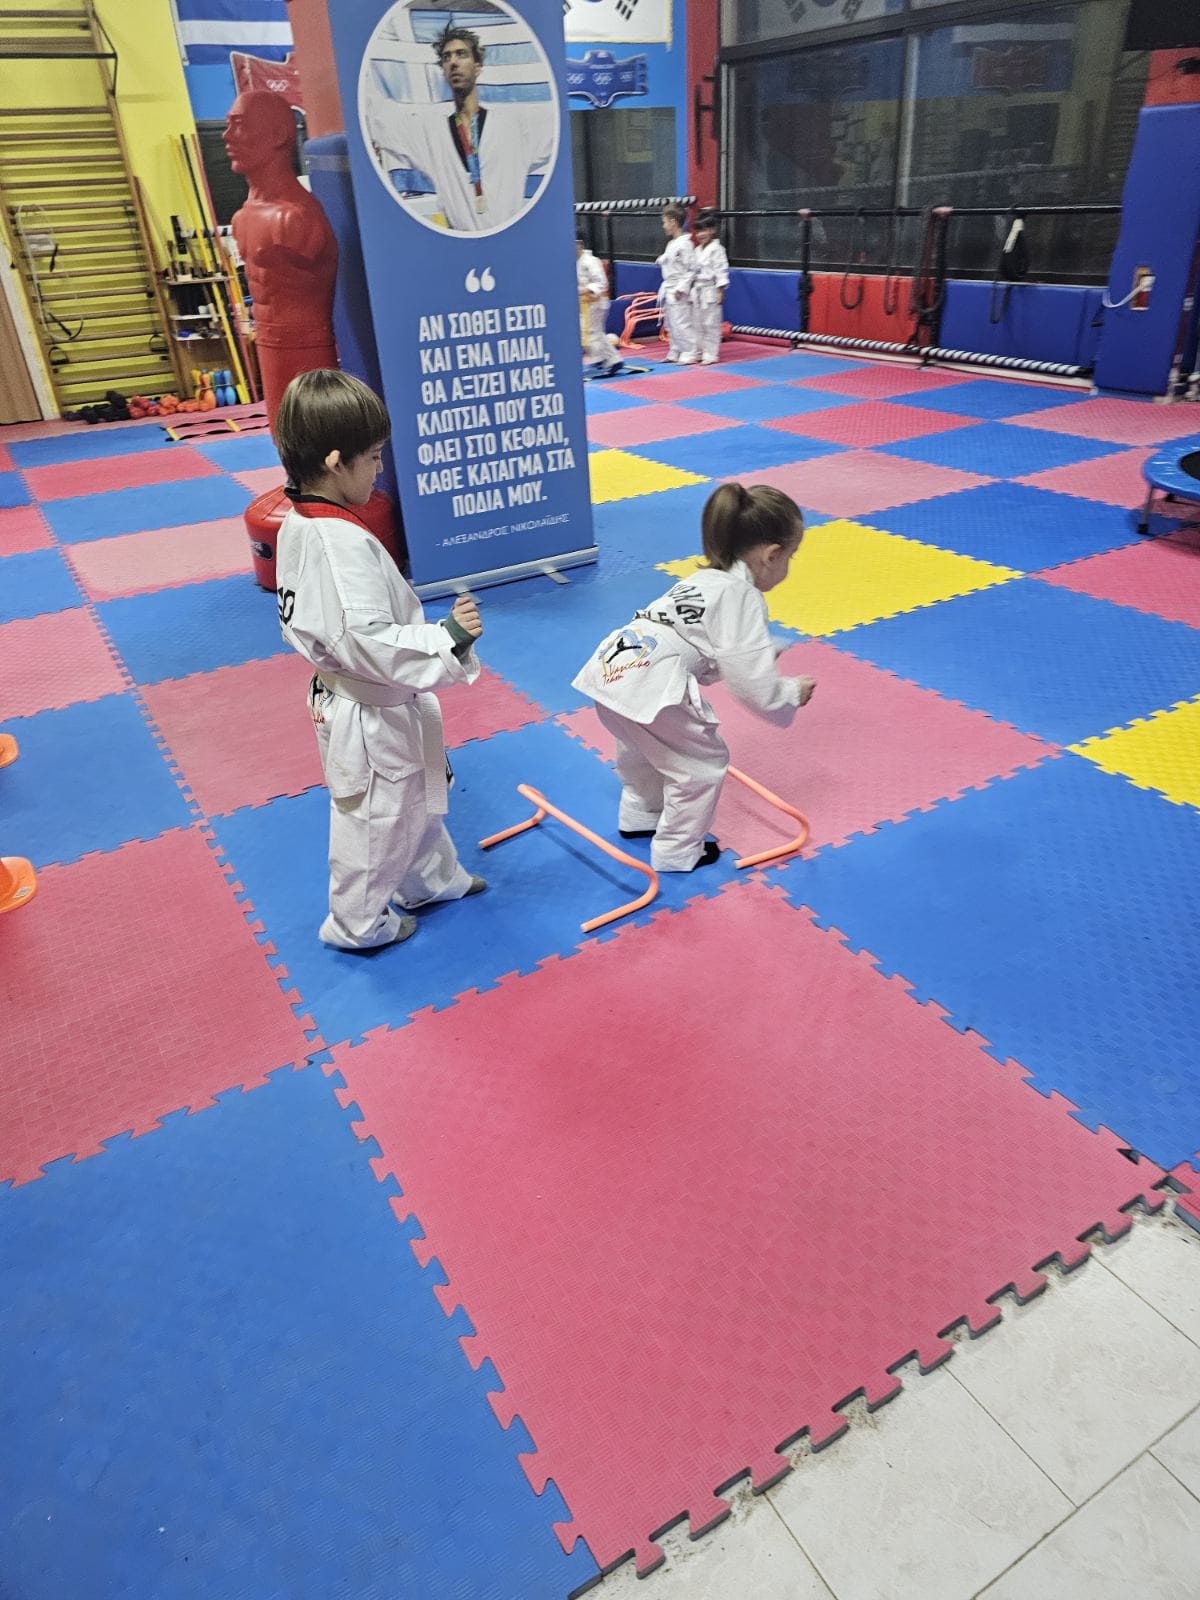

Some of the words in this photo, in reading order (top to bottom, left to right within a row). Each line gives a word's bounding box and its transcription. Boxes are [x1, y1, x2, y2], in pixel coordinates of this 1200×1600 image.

[419, 314, 446, 343] ΑΝ
[447, 308, 502, 339] ΣΩΘΕΙ
[504, 303, 547, 332] ΕΣΤΩ
[419, 346, 452, 375] ΚΑΙ
[456, 341, 495, 370] ΕΝΑ
[497, 335, 551, 364] ΠΑΙΔΙ,
[421, 379, 448, 406] ΘΑ
[452, 370, 507, 402] ΑΞΙΖΕΙ
[509, 364, 556, 393] ΚΑΘΕ
[416, 404, 492, 437] ΚΛΩΤΣΙΑ
[494, 398, 527, 425] ΠΟΥ
[530, 392, 565, 419] ΕΧΩ
[417, 437, 462, 466] ΦΑΕΙ
[464, 432, 497, 459] ΣΤΟ
[501, 421, 570, 453] ΚΕΦΑΛΙ,
[416, 467, 465, 496] ΚΑΘΕ
[467, 453, 544, 487] ΚΑΤΑΓΜΑ
[546, 447, 576, 473] ΣΤΑ
[452, 488, 505, 518] ΠΟΔΙΑ
[507, 480, 548, 508] ΜΟΥ.
[442, 525, 510, 548] ΑΛΕΞΑΝΔΡΟΣ
